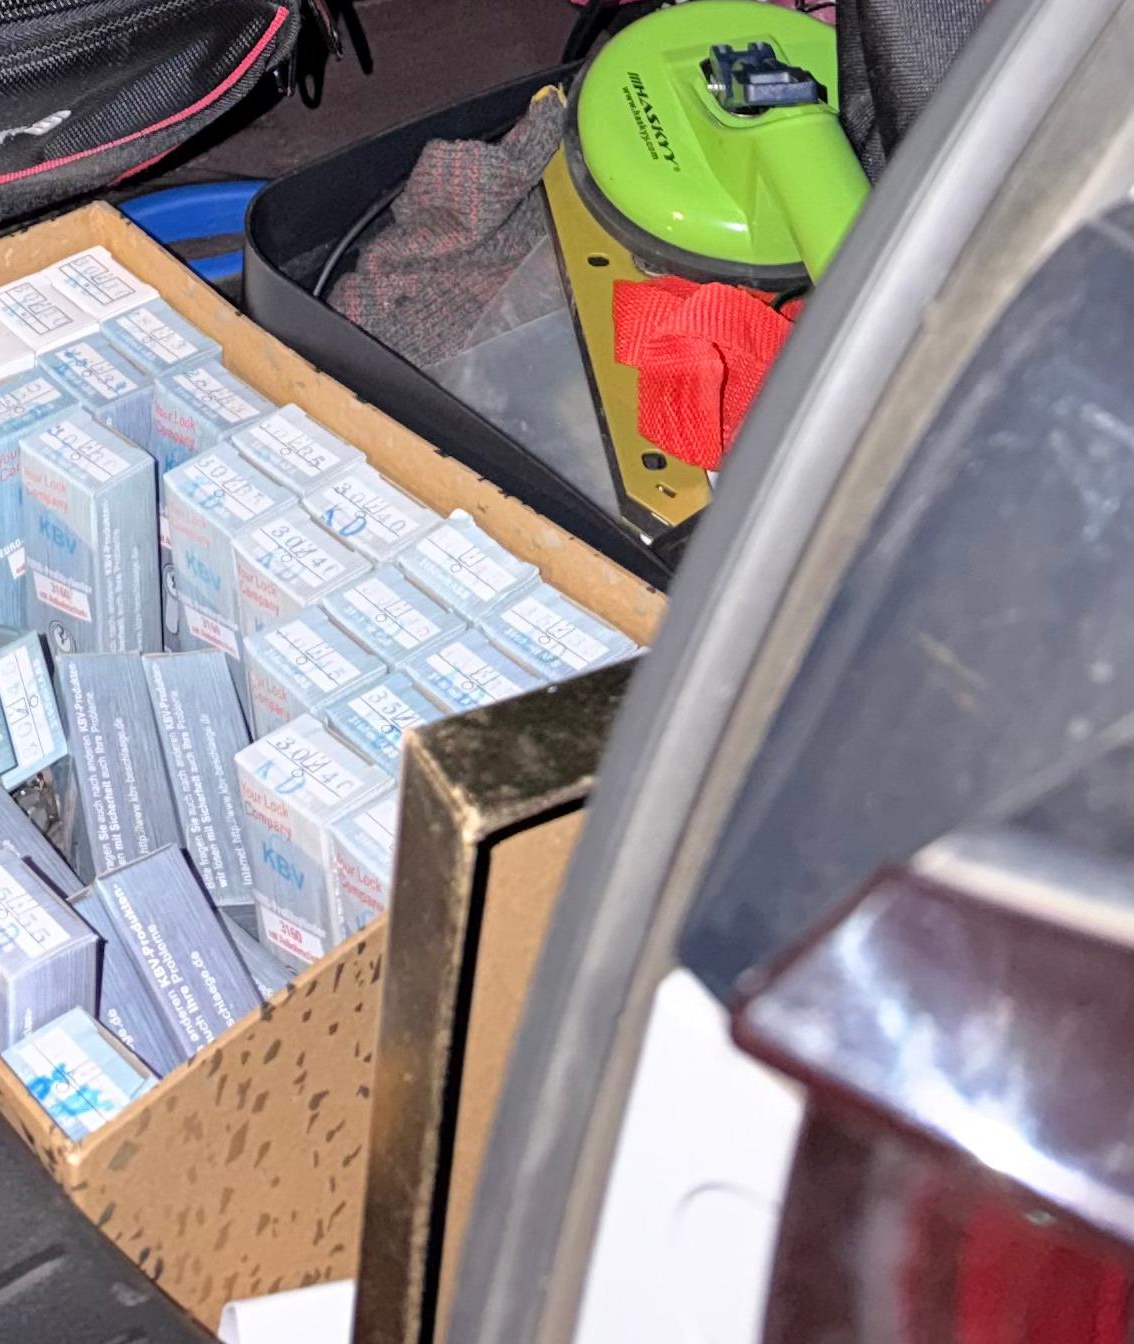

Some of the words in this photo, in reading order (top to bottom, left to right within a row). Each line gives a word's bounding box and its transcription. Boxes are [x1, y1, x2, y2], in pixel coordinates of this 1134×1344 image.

[38, 514, 77, 555] KBV
[185, 548, 222, 591] KBV
[67, 660, 90, 733] KBV-Produkten-
[168, 689, 188, 730] Probleme
[367, 688, 404, 715] 35
[84, 691, 101, 733] Probleme
[80, 733, 96, 772] anderen
[92, 734, 105, 754] Ihre
[167, 730, 185, 768] anderen
[179, 730, 193, 749] Ihre
[275, 735, 310, 761] 30
[96, 755, 109, 779] auch
[184, 750, 199, 774] auch
[88, 774, 101, 797] nach
[176, 768, 191, 792] nach
[92, 799, 106, 823] auch
[100, 779, 120, 831] Sicherheit
[182, 793, 197, 816] auch
[190, 774, 212, 823] Sicherheit
[264, 796, 290, 818] Lock
[97, 823, 109, 841] Sie
[188, 815, 201, 833] Sie
[203, 824, 216, 841] mit
[244, 801, 292, 842] Company
[111, 832, 123, 851] mit
[192, 833, 210, 866] fragen
[214, 870, 227, 888] wir
[262, 841, 305, 891] KBV
[113, 882, 170, 989] KBV-Produkten-
[146, 923, 184, 985] Probleme
[176, 983, 200, 1013] Ihre
[164, 989, 201, 1043] anderen
